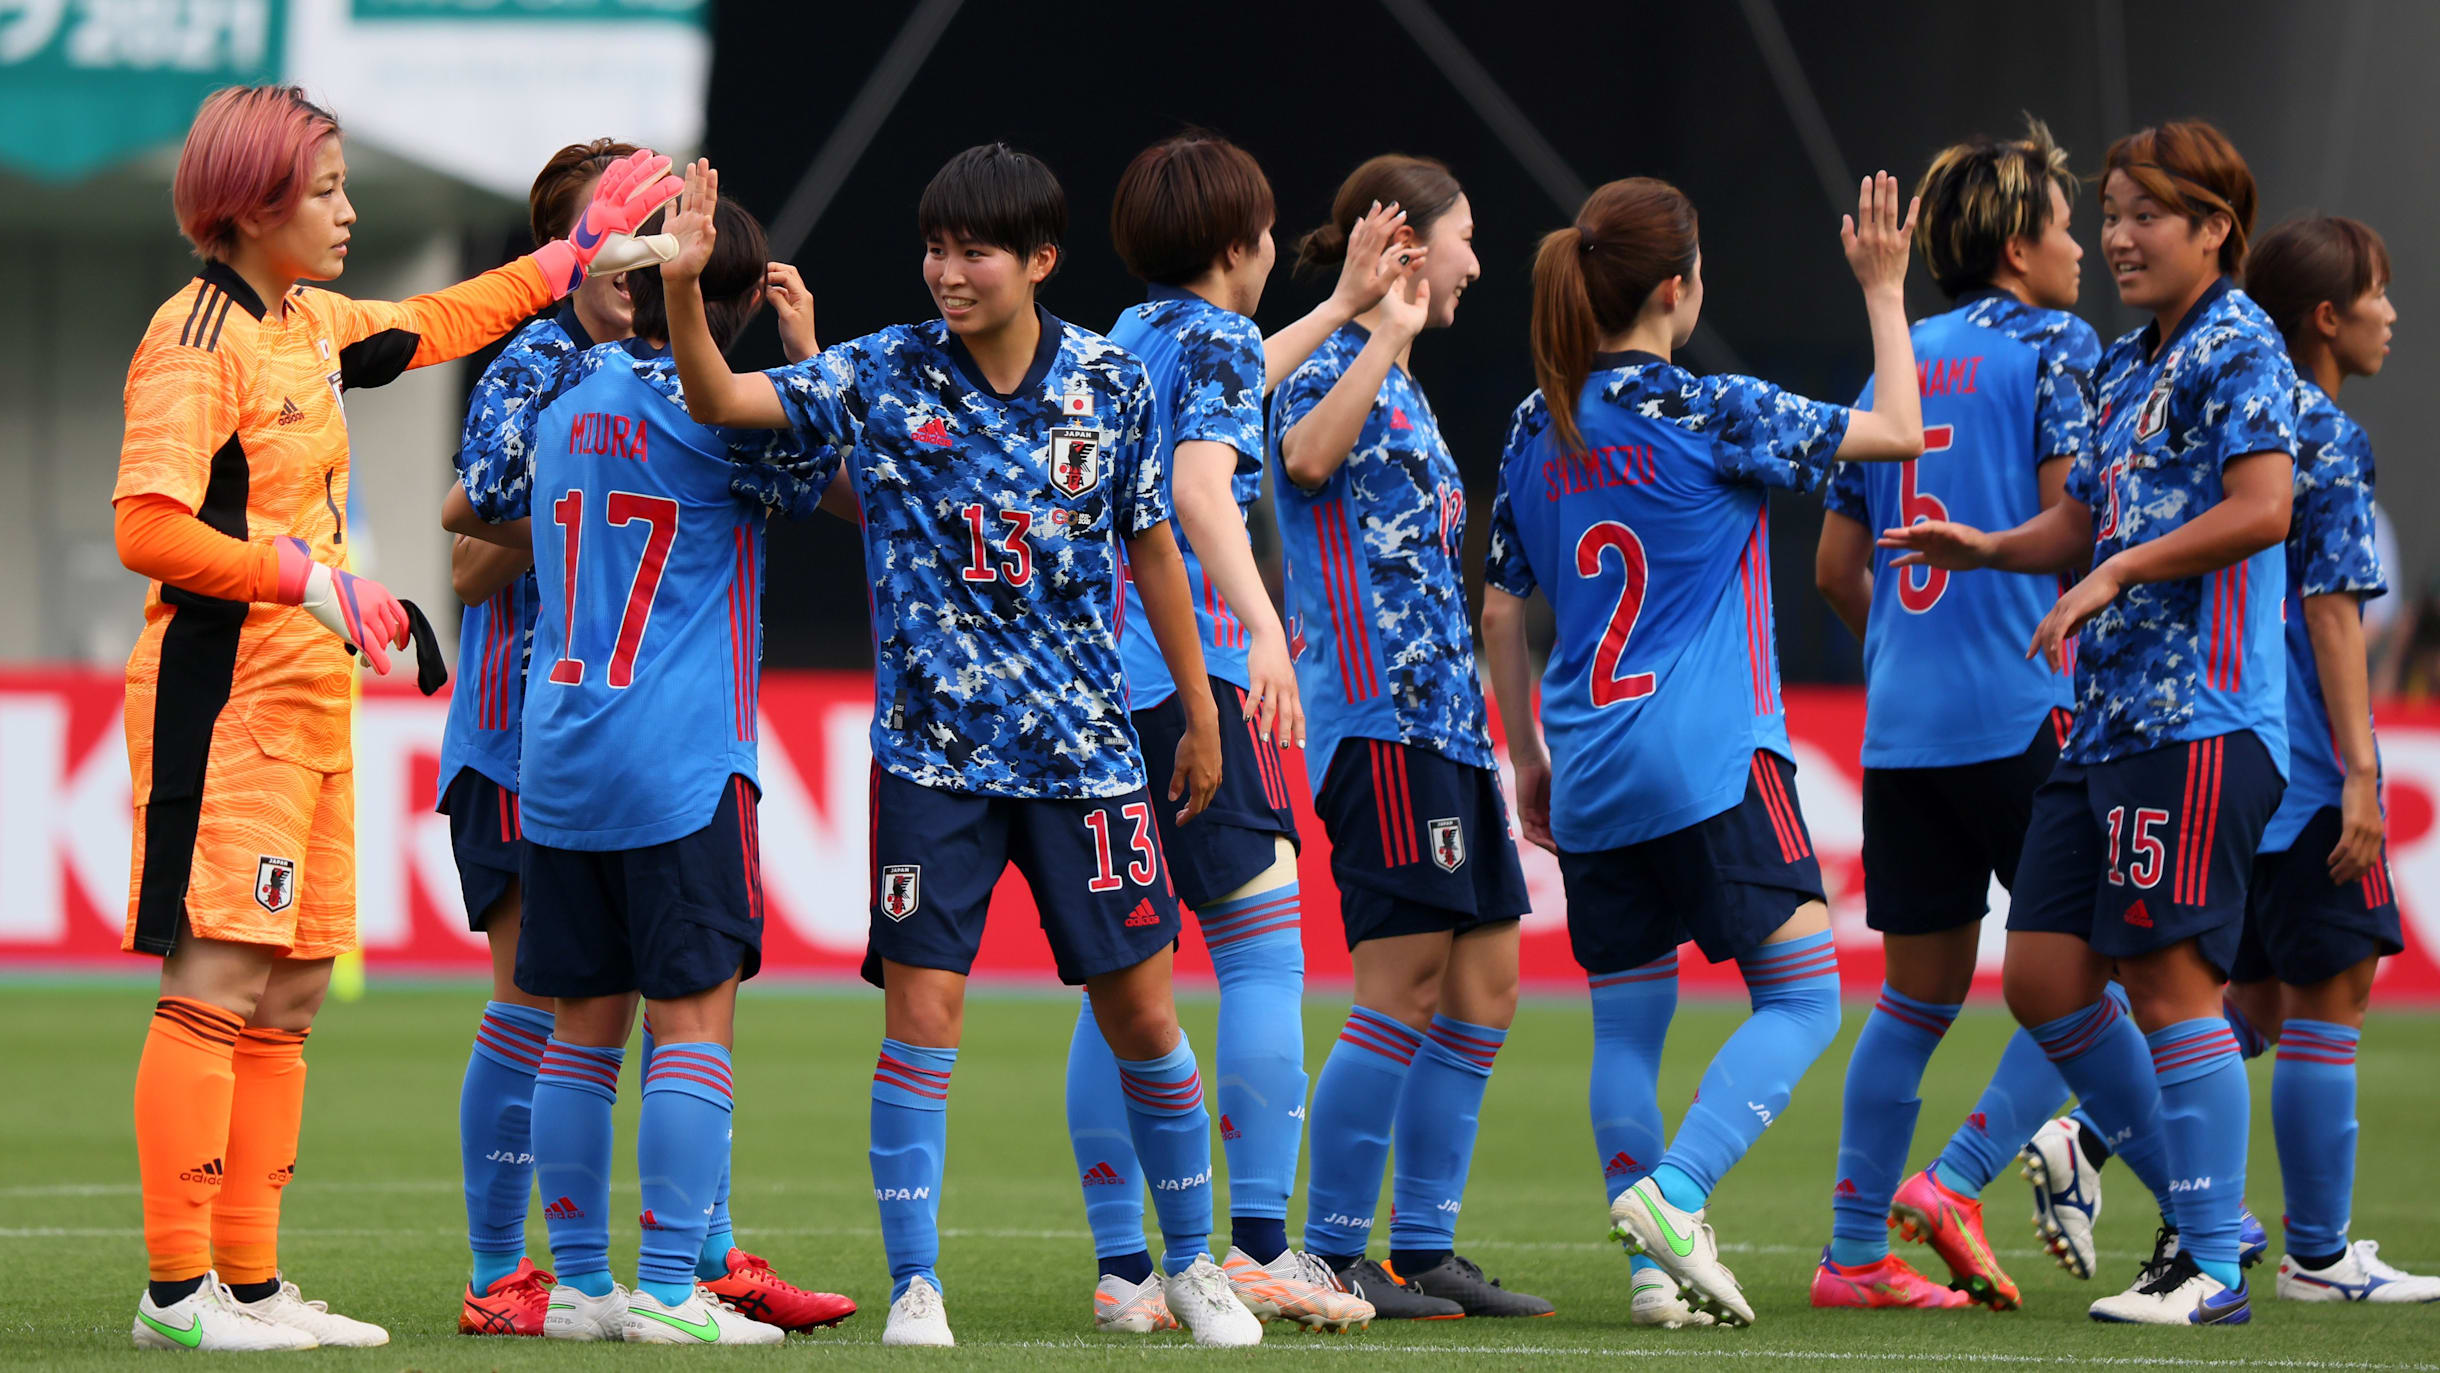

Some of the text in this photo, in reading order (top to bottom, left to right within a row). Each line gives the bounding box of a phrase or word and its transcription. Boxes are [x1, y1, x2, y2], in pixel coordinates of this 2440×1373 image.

[568, 412, 649, 464] MIURA
[910, 431, 953, 448] adidas
[1063, 430, 1093, 438] JAPAN
[1542, 444, 1656, 503] SHIMIZU
[962, 502, 1033, 588] 13
[548, 488, 680, 690] 17
[1575, 519, 1657, 709] 2
[1084, 801, 1158, 893] 13
[2107, 805, 2170, 890] 15
[2168, 1176, 2212, 1192] PAN
